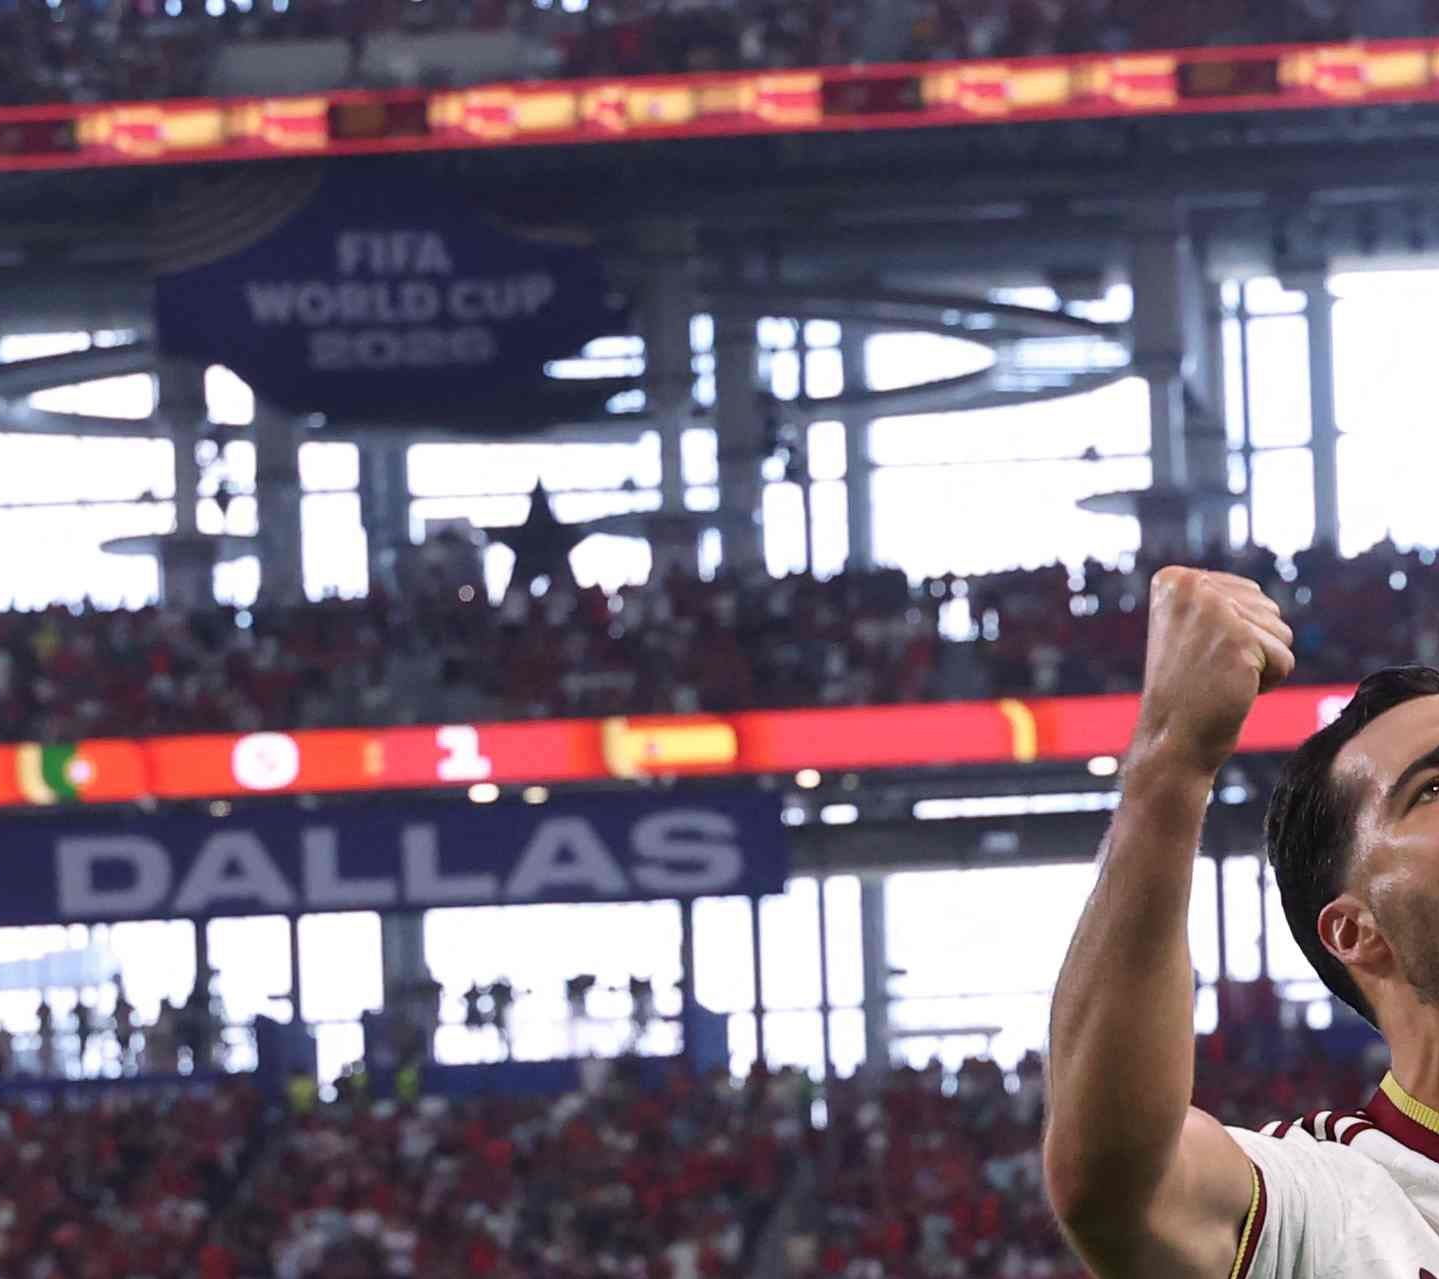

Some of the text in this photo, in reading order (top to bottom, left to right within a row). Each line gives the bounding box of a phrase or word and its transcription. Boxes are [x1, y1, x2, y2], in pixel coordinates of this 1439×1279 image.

[336, 231, 453, 275] FIFA
[245, 272, 556, 325] WORLD CUP
[436, 725, 492, 780] 1
[56, 809, 744, 913] DALLAS
